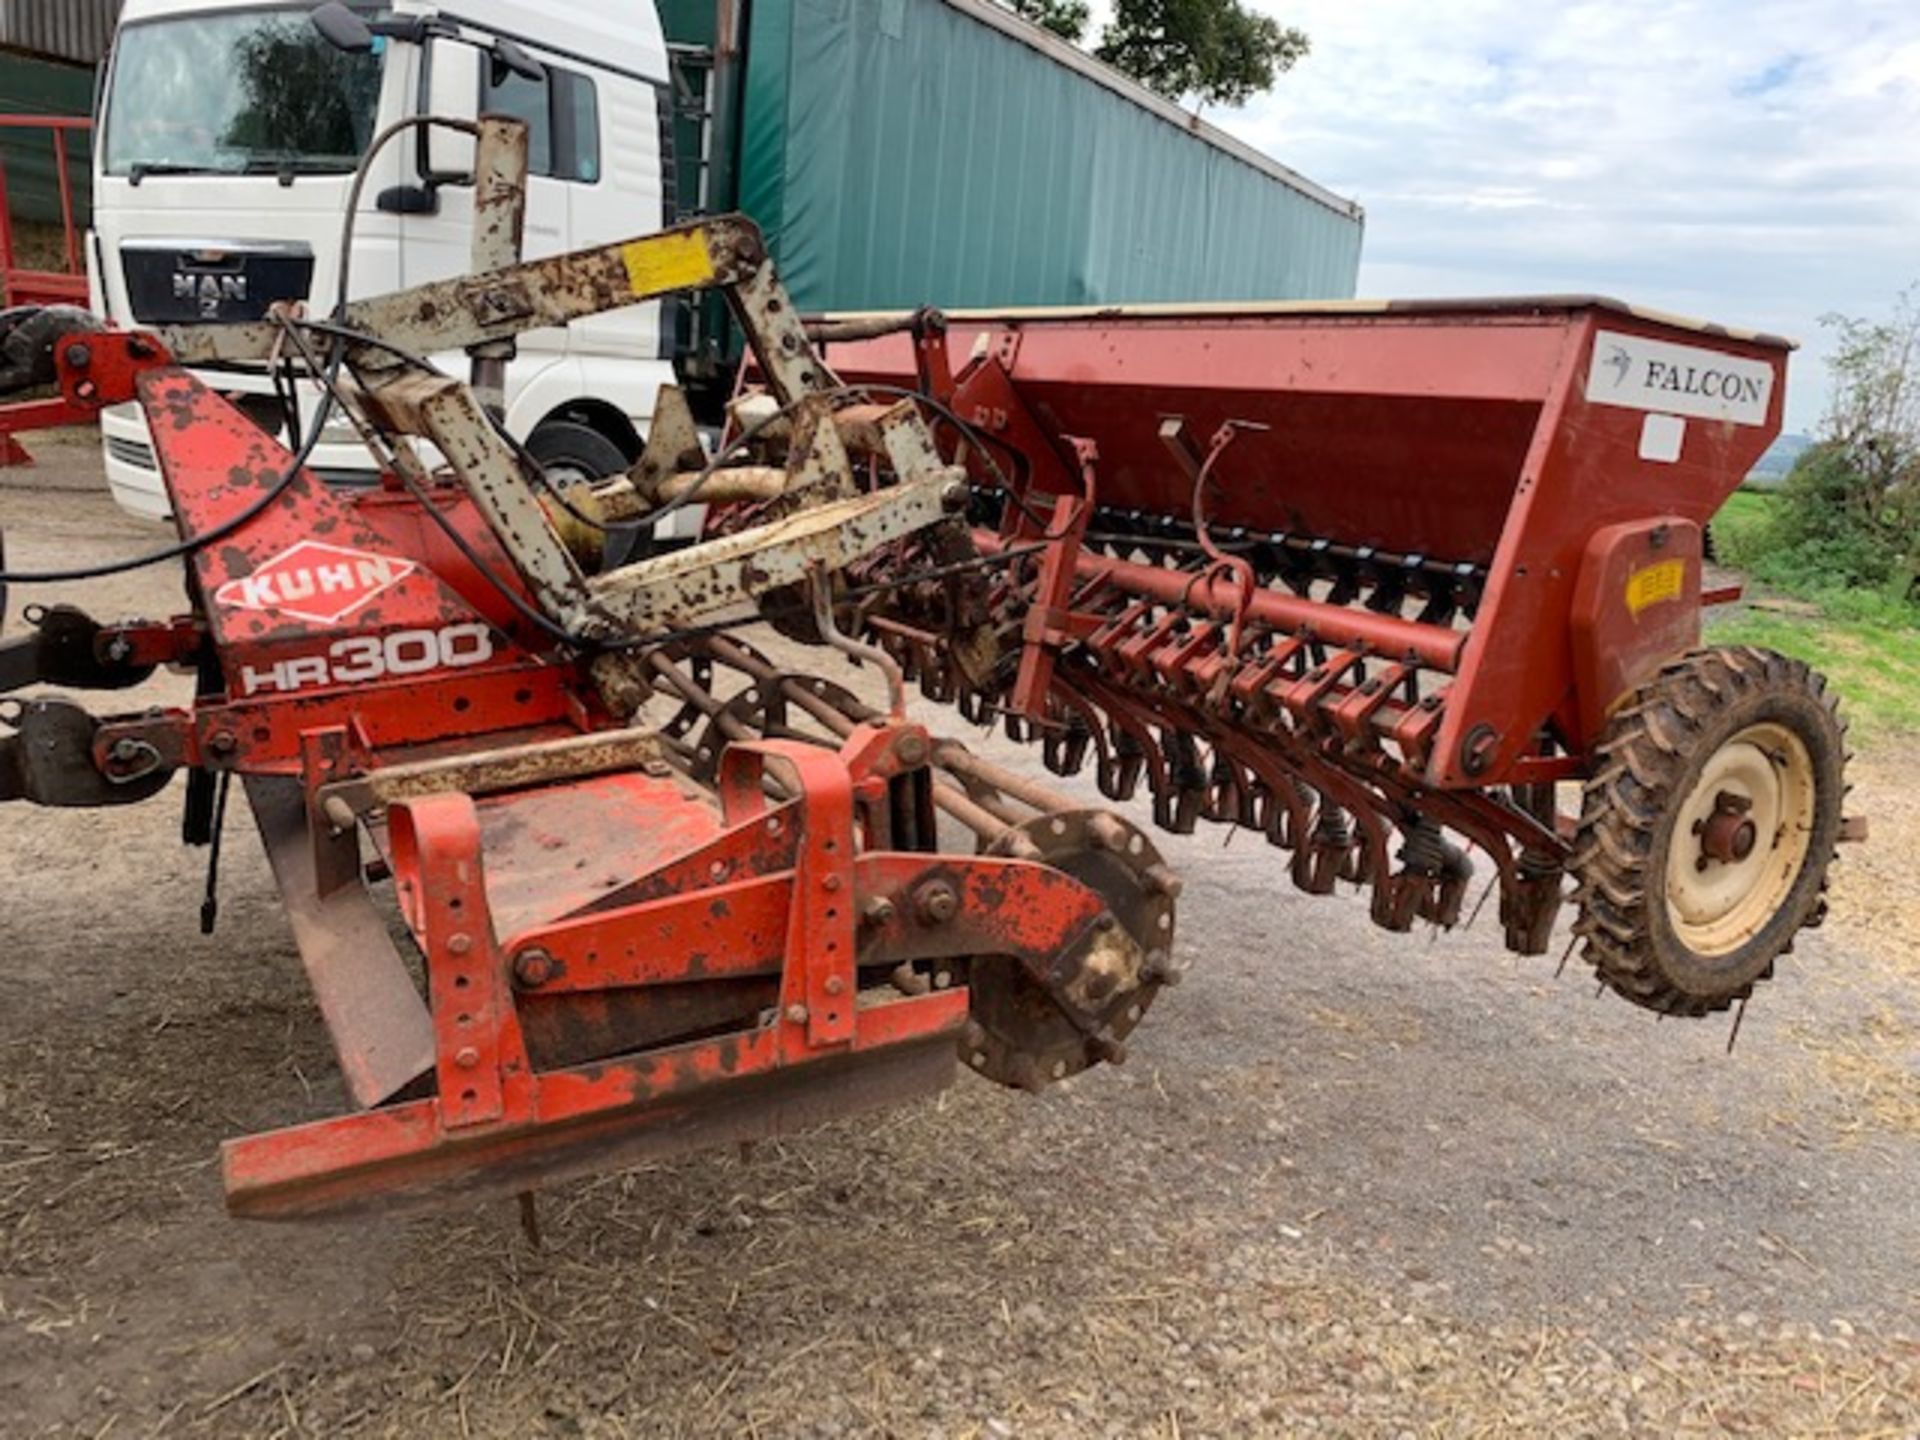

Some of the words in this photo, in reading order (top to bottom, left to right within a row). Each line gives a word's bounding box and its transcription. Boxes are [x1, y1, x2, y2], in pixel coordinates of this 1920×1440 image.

[173, 273, 247, 300] MAN
[1644, 360, 1763, 402] FALCON
[241, 557, 392, 605] KUHN
